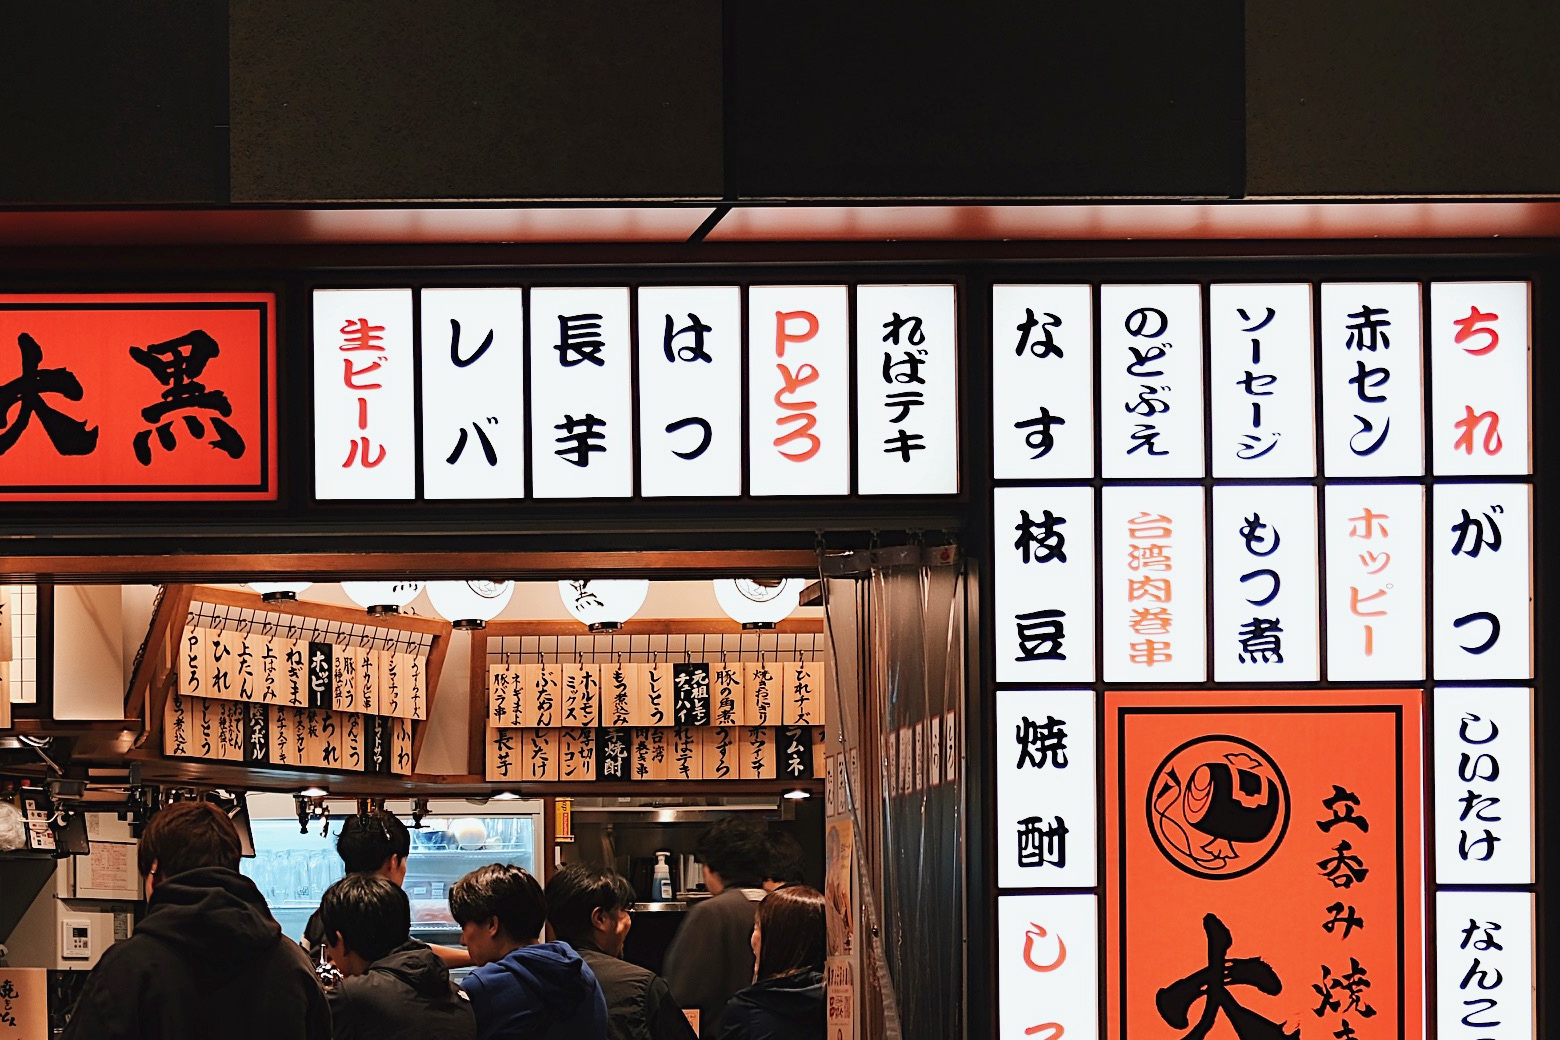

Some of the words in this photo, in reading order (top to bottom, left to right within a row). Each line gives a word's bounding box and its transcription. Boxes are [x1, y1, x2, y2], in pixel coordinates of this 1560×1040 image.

[339, 318, 388, 468] 生ビール
[446, 319, 498, 466] レバ
[553, 314, 607, 467] 長芋
[664, 313, 712, 460] はつ
[882, 312, 928, 463] ればテキ
[1014, 308, 1065, 459] なす
[1125, 308, 1172, 455] のどぶえ
[1236, 307, 1281, 460] ソーセージ
[1346, 305, 1391, 456] 赤セン
[1453, 306, 1502, 456] ちれ
[1014, 510, 1067, 662] 枝豆
[1128, 512, 1172, 666] 台湾肉巻串
[1238, 512, 1283, 664] もつ煮
[1350, 508, 1390, 655] ホッピー
[1451, 505, 1504, 655] がつ
[212, 641, 231, 693] ひれ
[238, 642, 254, 700] 上たん
[262, 644, 277, 702] 上はらみ
[286, 648, 304, 706] ねぎま
[311, 651, 329, 706] ホッピー
[344, 657, 356, 708] 豚バラ
[388, 660, 398, 714] シマチョウ
[494, 674, 510, 723] 豚バラ串
[536, 671, 557, 726] ぶためん
[566, 676, 578, 720] ミックス
[579, 671, 597, 726] ホルモン
[612, 671, 630, 725] もつ煮込み
[649, 670, 664, 724] ししとう
[675, 673, 691, 723] チューハイ
[691, 670, 709, 725] 元祖レモン
[715, 670, 740, 725] 豚の角煮
[753, 670, 773, 725] 焼きおにぎり
[794, 670, 813, 724] ひれチーズ
[173, 696, 187, 754] もつ煮込み
[201, 699, 211, 756] ししとう
[322, 712, 340, 765] ちれ
[397, 721, 411, 770] ふわ
[578, 728, 594, 775] 厚切り
[651, 728, 665, 763] 台湾
[674, 726, 693, 778] ればテキ
[786, 727, 804, 777] ラムネ
[494, 729, 514, 777] 長芋
[531, 728, 549, 779] しいたけ
[563, 729, 577, 777] ベーコン
[716, 728, 730, 778] うずら
[1016, 716, 1069, 868] 焼酎
[1458, 712, 1501, 861] しいたけ
